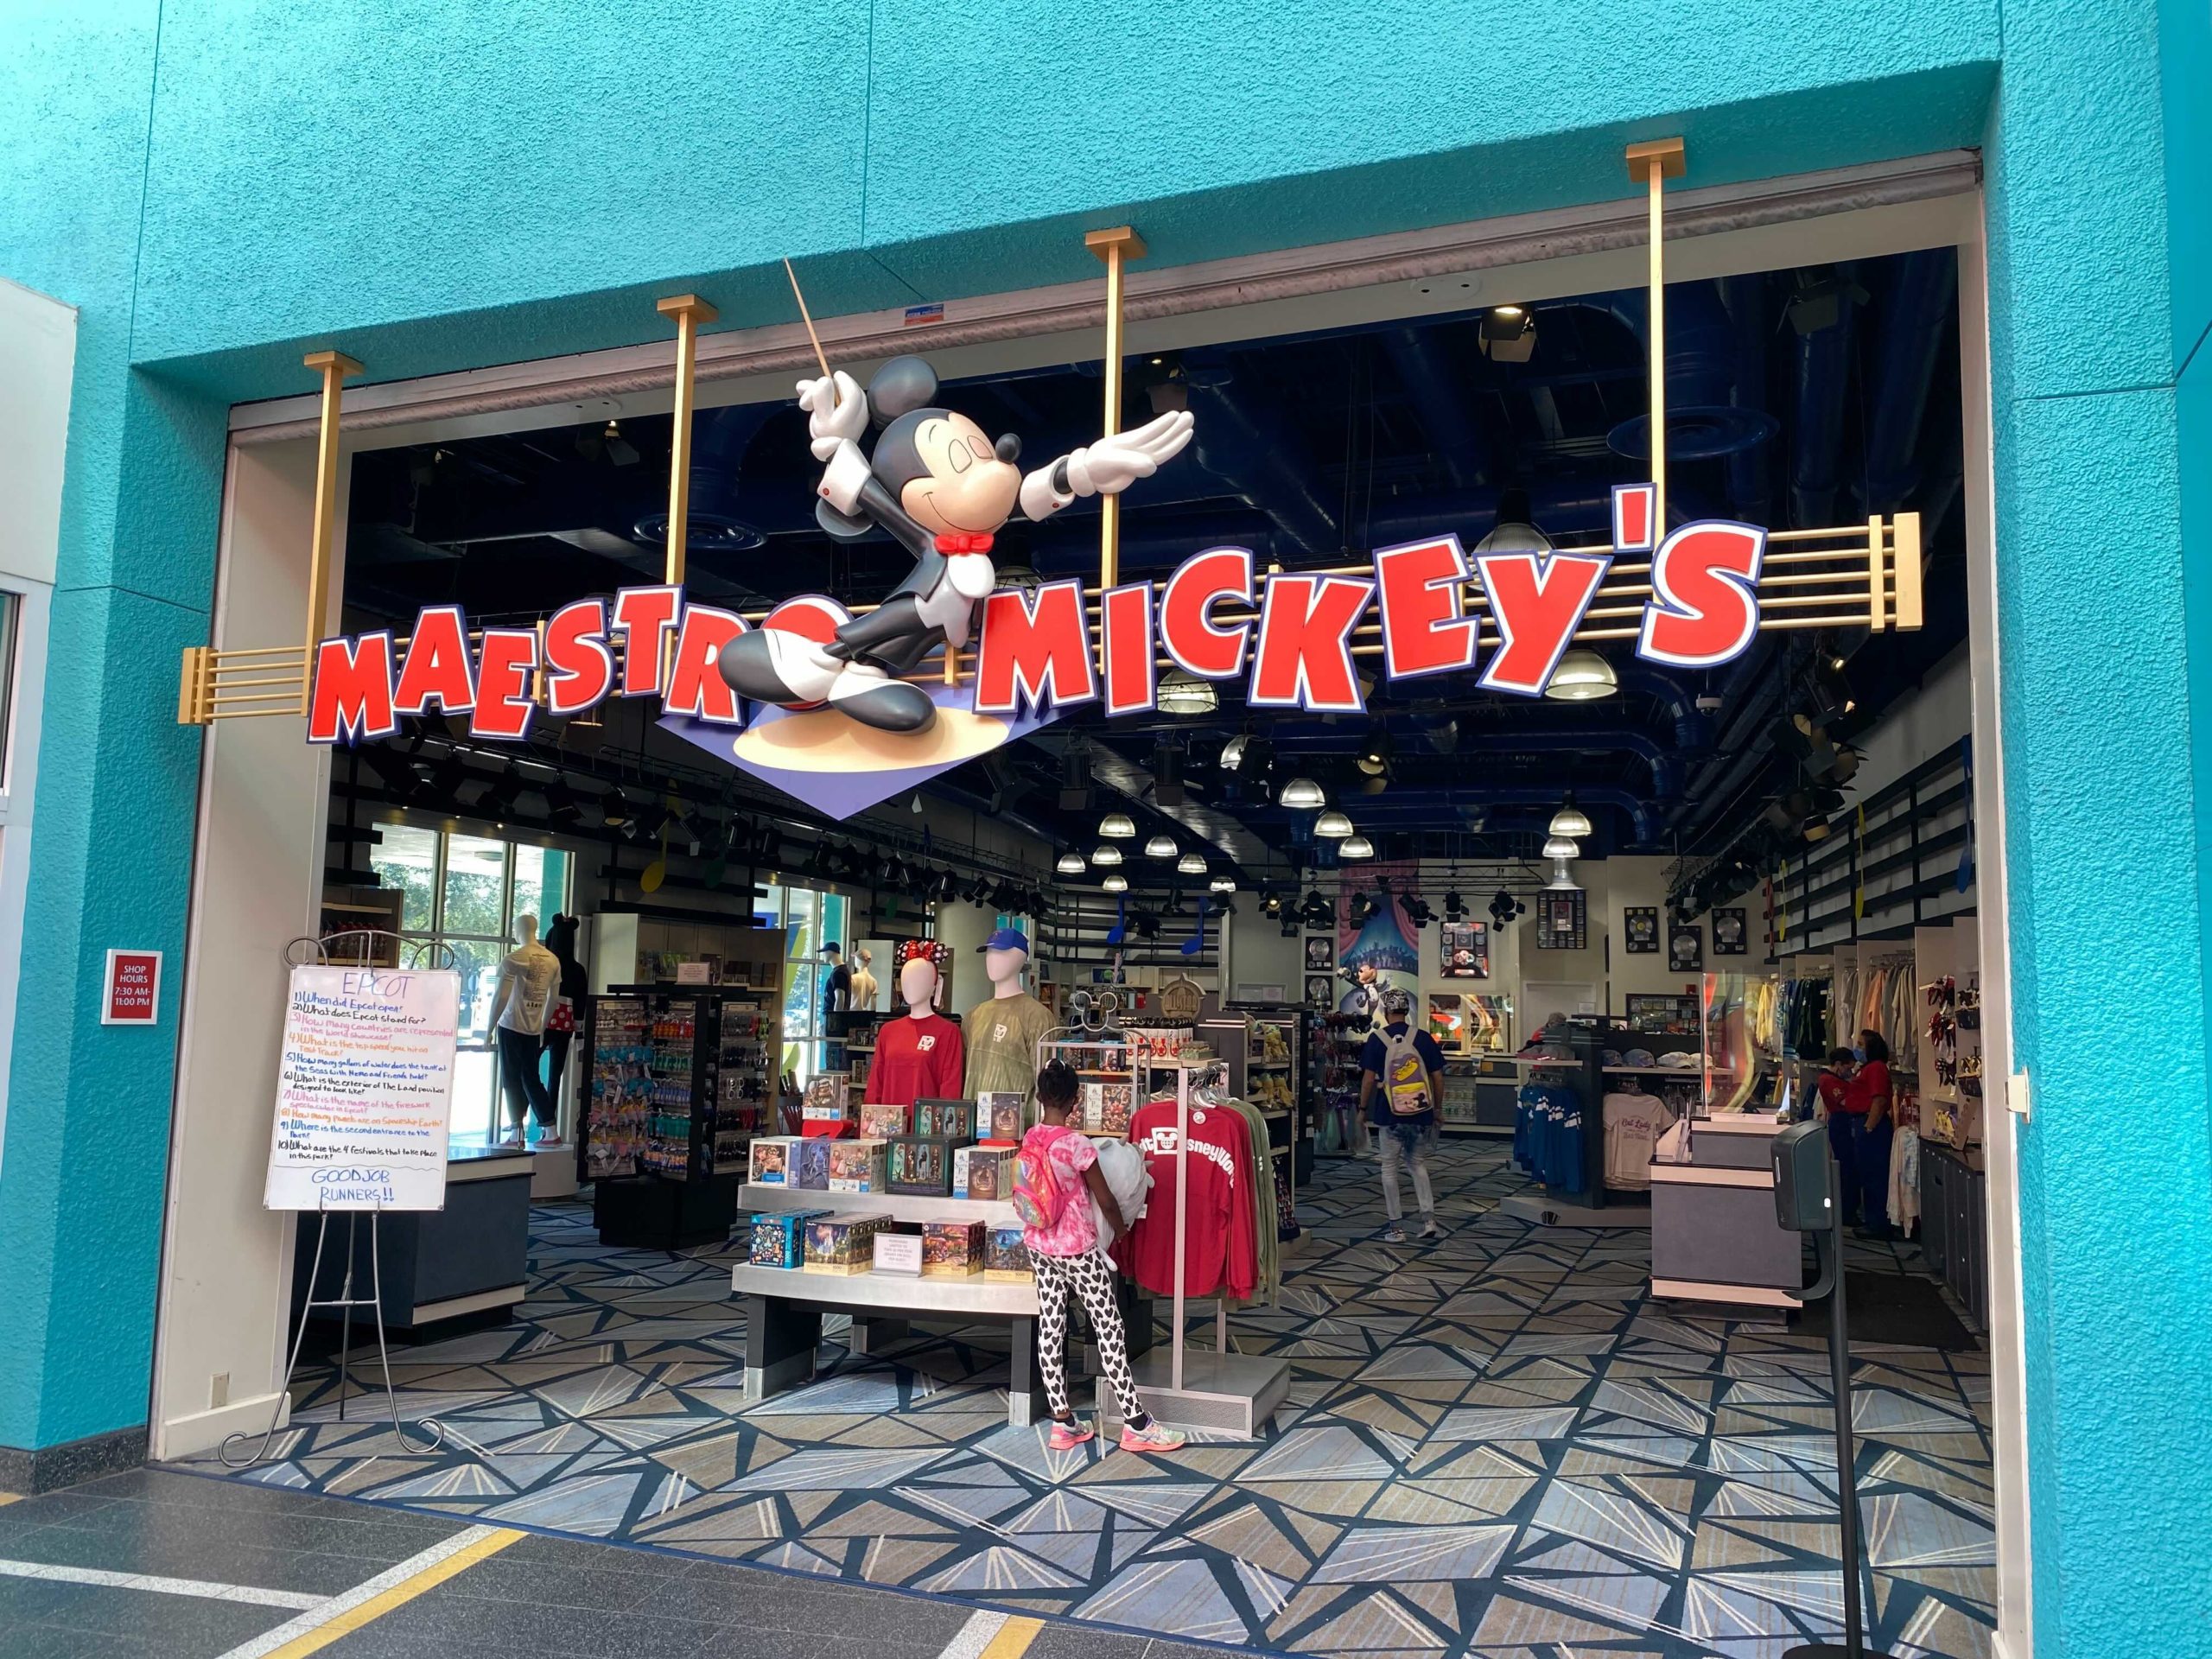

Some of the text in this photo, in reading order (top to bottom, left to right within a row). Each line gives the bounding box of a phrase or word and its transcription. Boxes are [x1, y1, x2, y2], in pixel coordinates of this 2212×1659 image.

[973, 483, 1767, 716] MICKEY'S
[124, 965, 147, 974] SHOP
[119, 975, 148, 983] HOURS
[343, 972, 415, 999] EPCOT
[302, 1003, 331, 1015] What
[331, 1008, 351, 1017] does
[353, 1011, 379, 1021] Epcot
[350, 999, 376, 1010] Epcot
[300, 1033, 328, 1046] What
[339, 1040, 353, 1049] the
[296, 1052, 316, 1064] How
[294, 1071, 316, 1083] What
[327, 1077, 341, 1086] the
[291, 1090, 320, 1103] What
[330, 1096, 345, 1105] the
[290, 1118, 320, 1131] Where
[289, 1140, 312, 1151] What
[328, 1145, 342, 1154] the
[350, 1145, 385, 1155] festivals
[311, 1169, 361, 1183] GOOD
